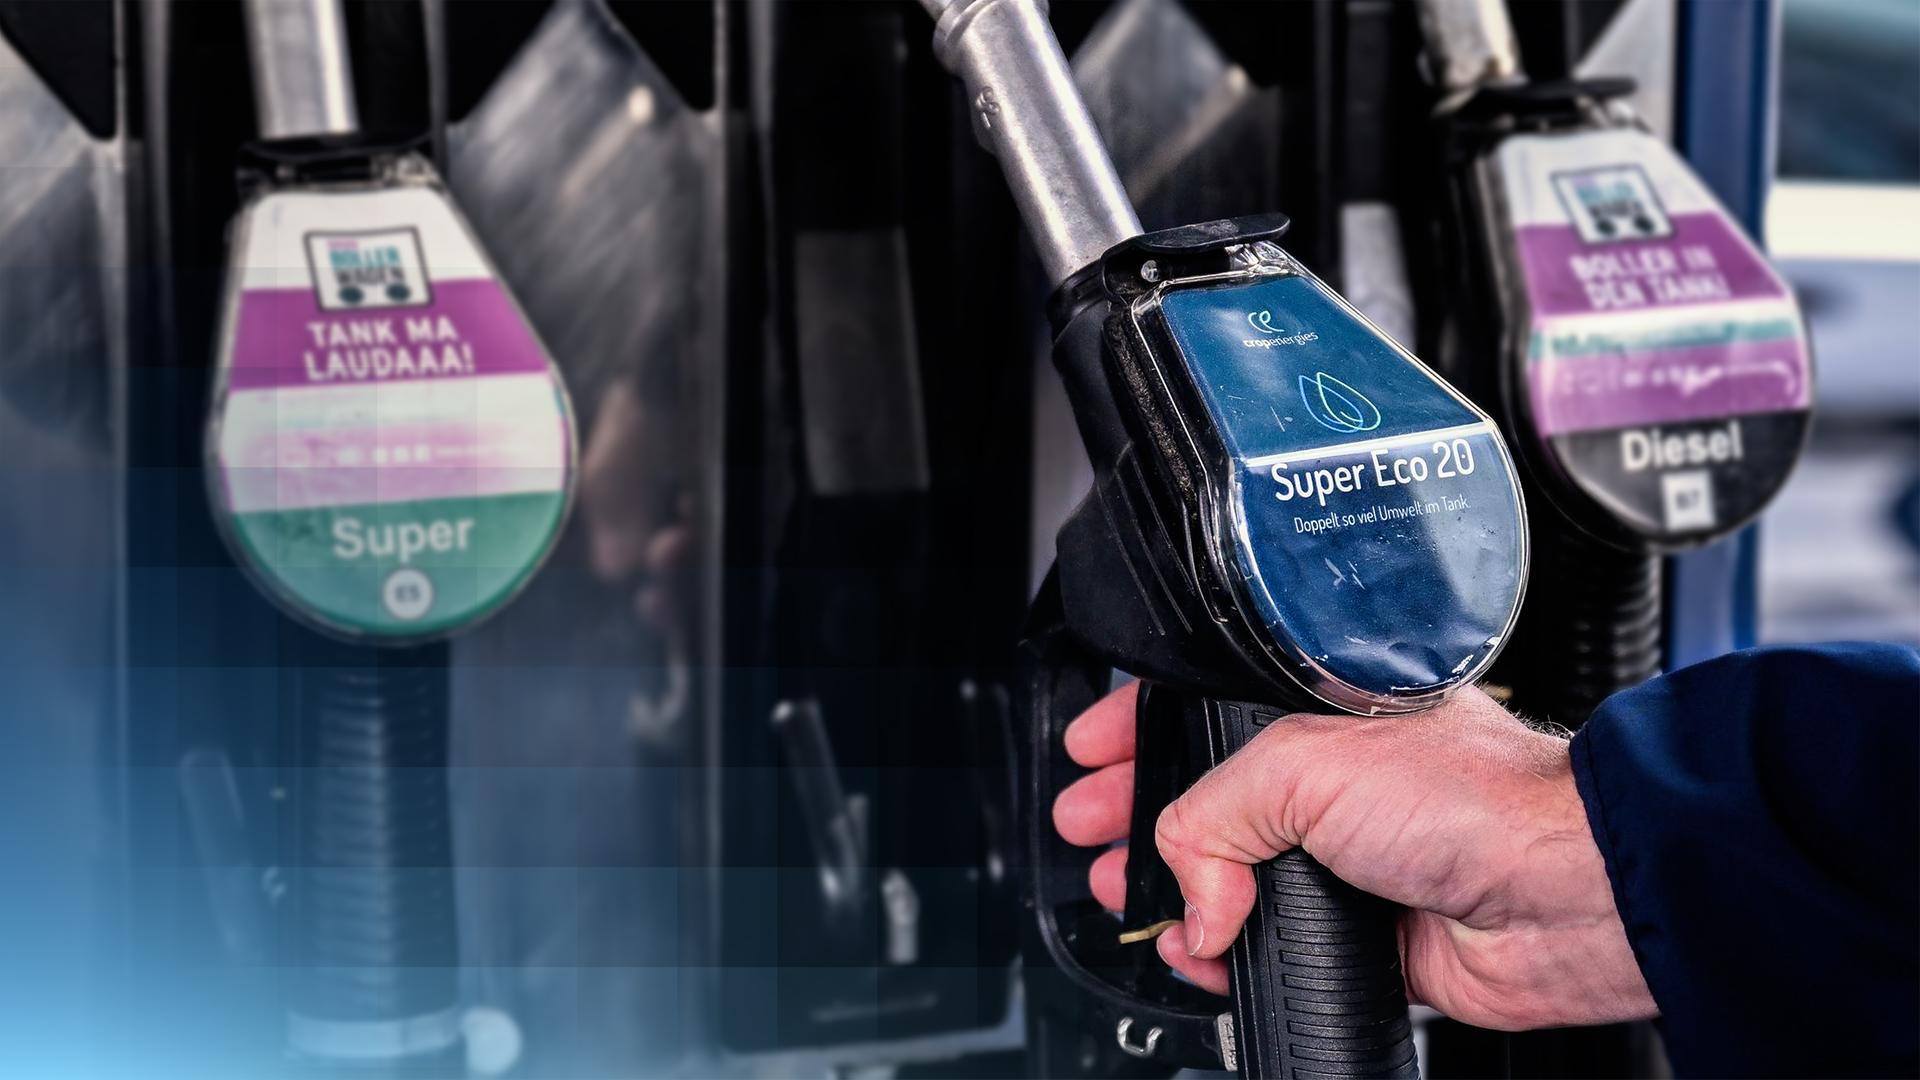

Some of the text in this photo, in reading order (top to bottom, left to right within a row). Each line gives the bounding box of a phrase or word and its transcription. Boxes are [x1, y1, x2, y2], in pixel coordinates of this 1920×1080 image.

[307, 314, 460, 348] TANK MA
[1243, 331, 1319, 349] cropenergies
[304, 342, 477, 381] LAUDAAA!
[1620, 419, 1744, 472] Diesel
[1271, 437, 1476, 507] Super Eco 20
[1294, 512, 1340, 535] Doppelt
[1343, 514, 1356, 527] so
[1357, 505, 1377, 524] viel
[1377, 500, 1424, 521] Umwelt
[1425, 502, 1440, 514] im
[331, 516, 475, 564] Super
